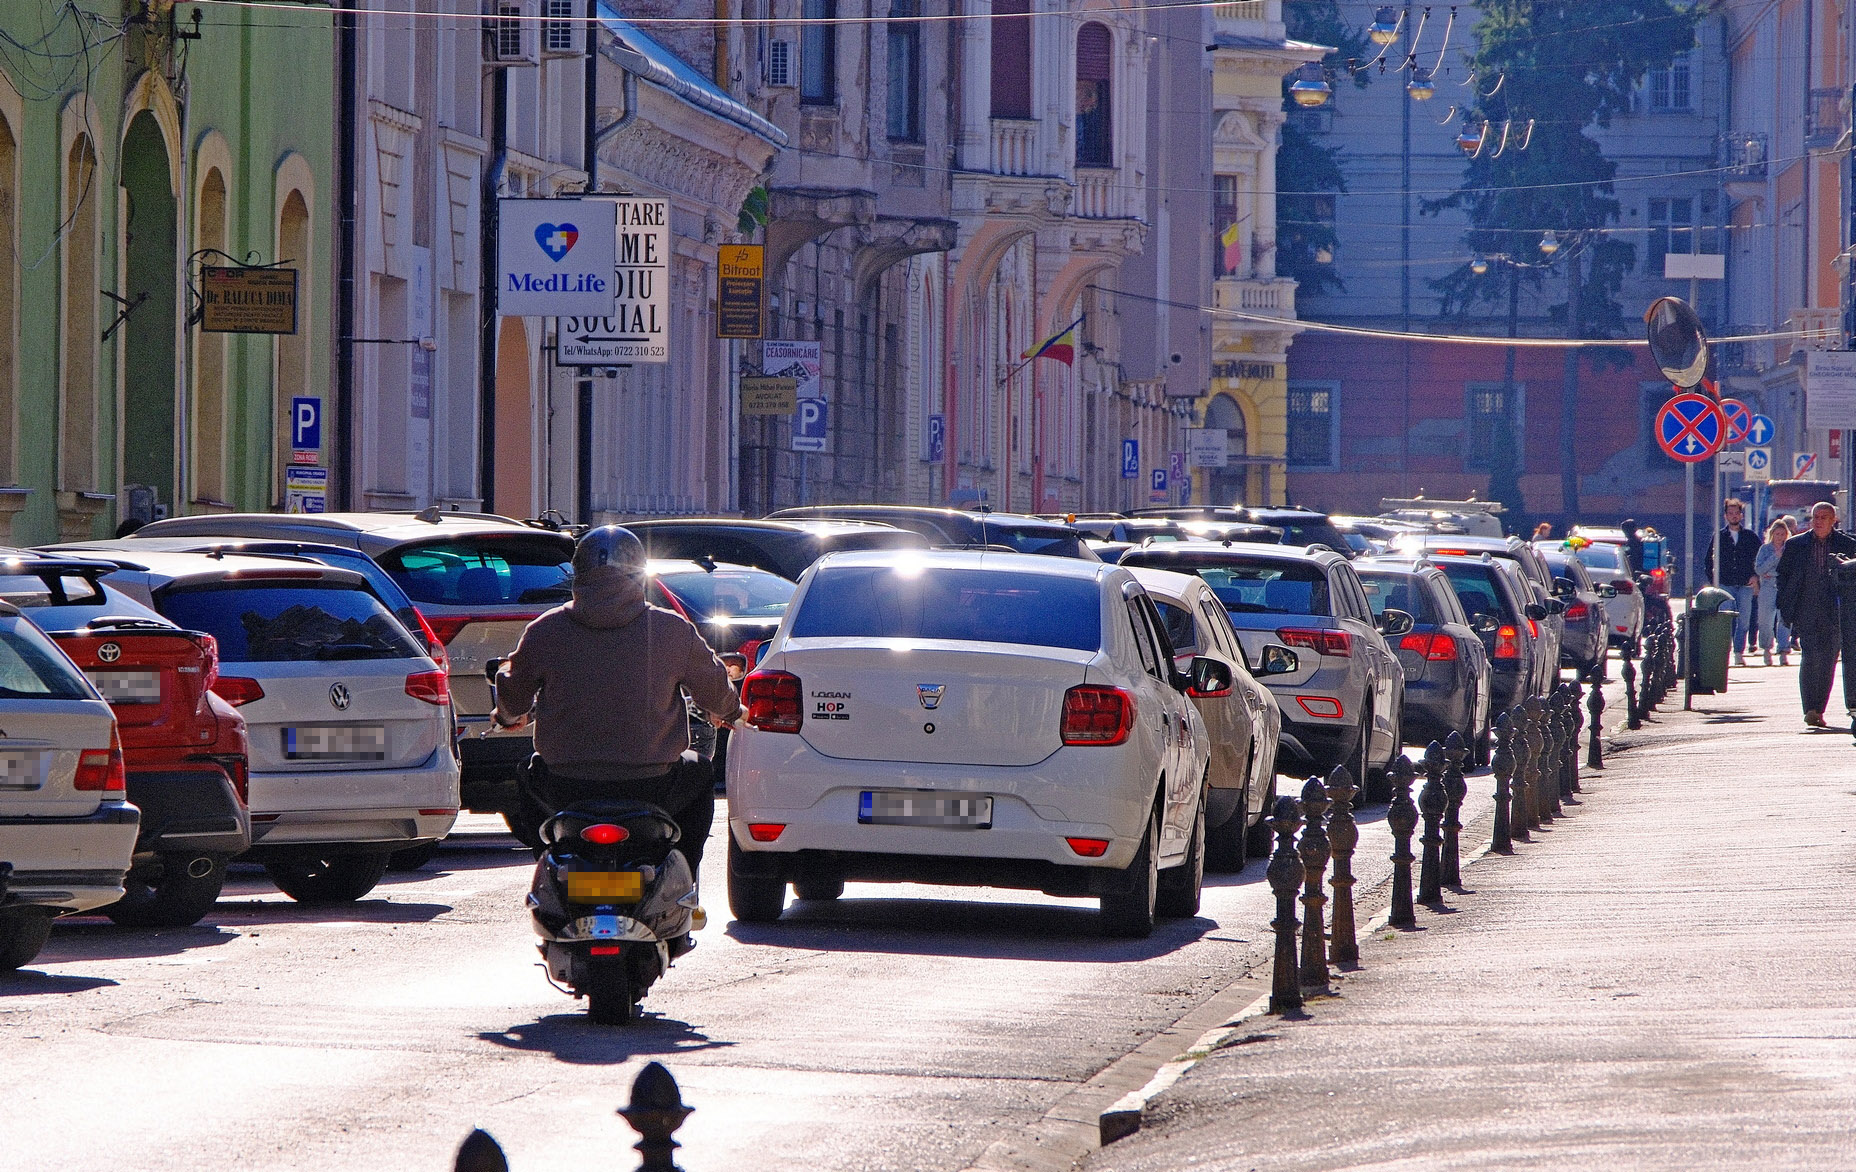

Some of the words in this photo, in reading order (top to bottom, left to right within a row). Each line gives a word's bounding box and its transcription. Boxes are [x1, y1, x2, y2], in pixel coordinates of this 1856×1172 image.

[615, 202, 665, 232] ȚARE
[722, 264, 760, 276] Bitroot
[507, 273, 606, 293] MedLife
[223, 290, 263, 305] RALUCA
[266, 291, 292, 305] DIMA
[566, 304, 662, 333] SOCIAL
[563, 346, 613, 357] Tel/WhatsApp:
[614, 346, 633, 356] 0722
[635, 347, 648, 356] 310
[651, 347, 665, 356] 523
[765, 346, 818, 359] CEASORNICĂRIE
[298, 404, 315, 443] P
[801, 403, 819, 435] P
[811, 691, 852, 699] LOGAN
[817, 702, 845, 712] HOP
